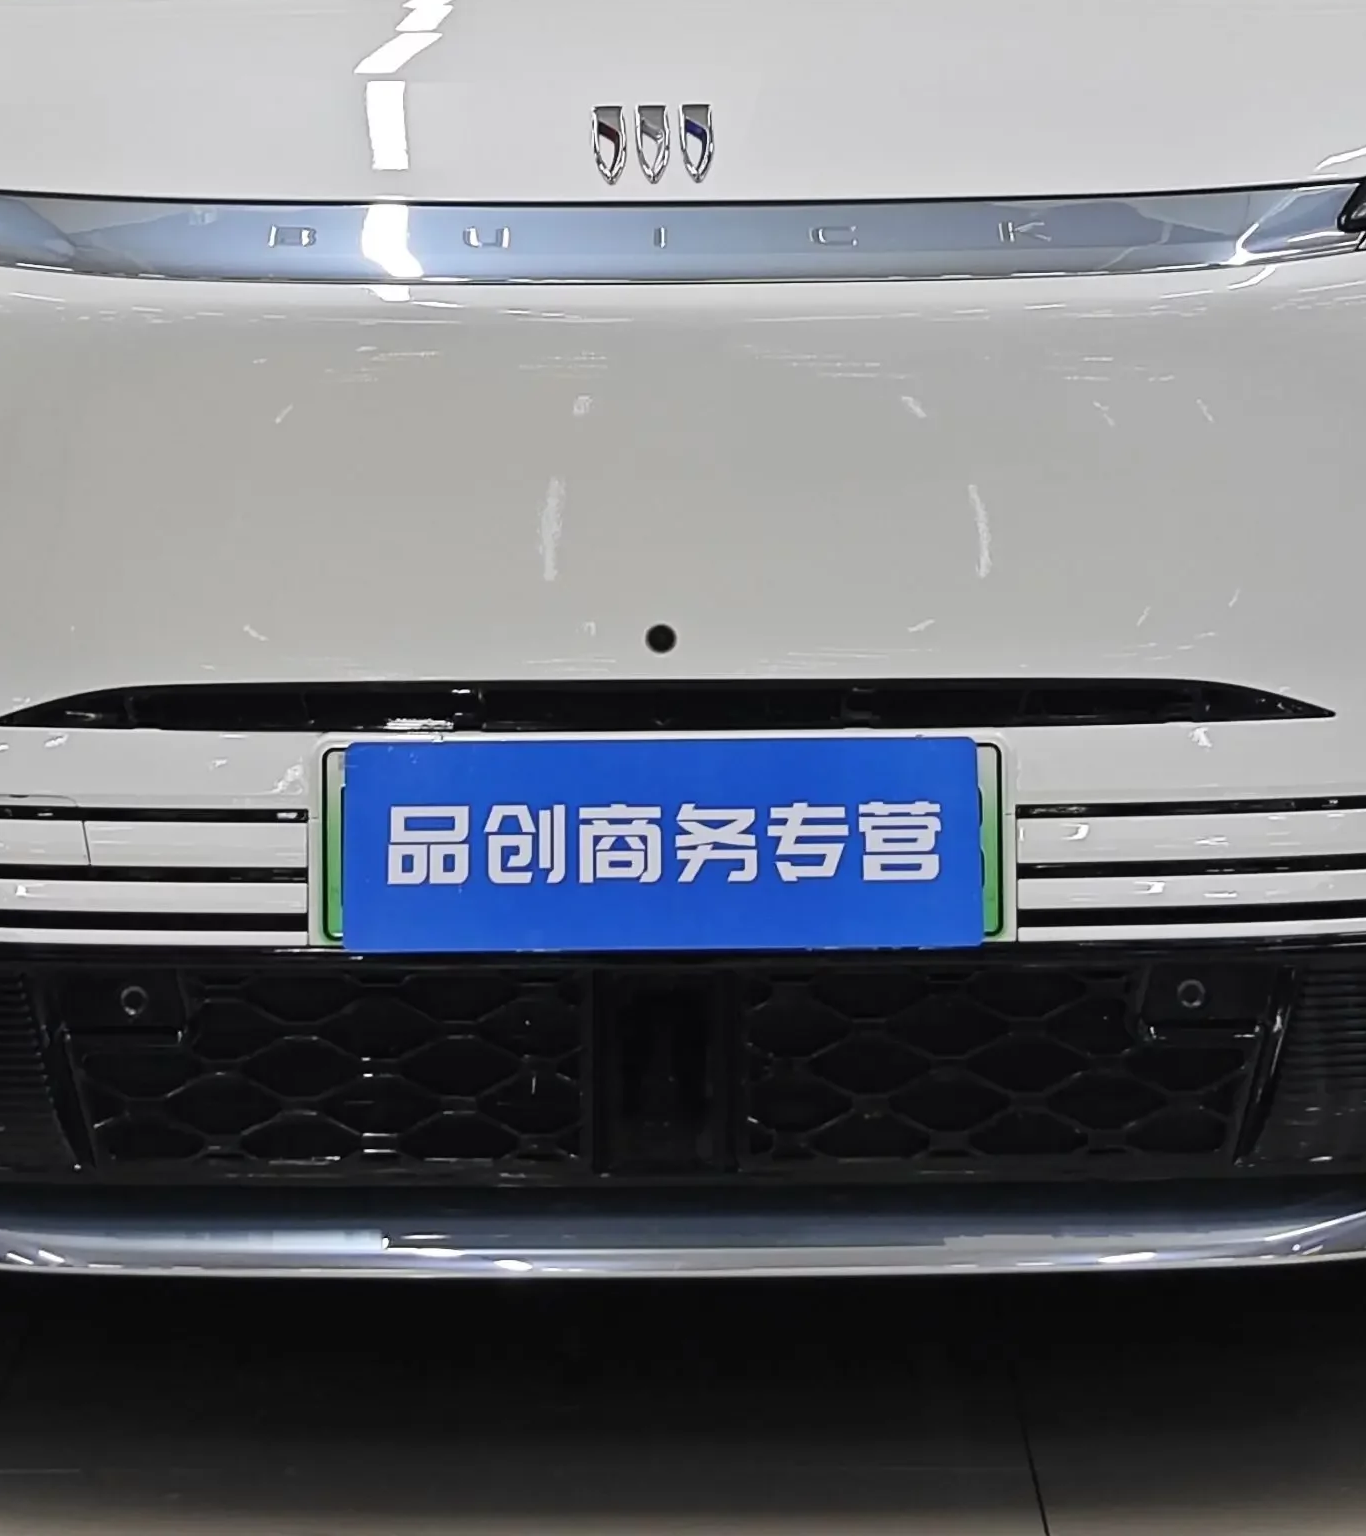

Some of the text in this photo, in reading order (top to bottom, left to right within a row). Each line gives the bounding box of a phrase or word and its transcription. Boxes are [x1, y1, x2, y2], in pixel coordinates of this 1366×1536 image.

[268, 218, 1052, 250] BUICK
[386, 801, 942, 886] 品创商务专营
